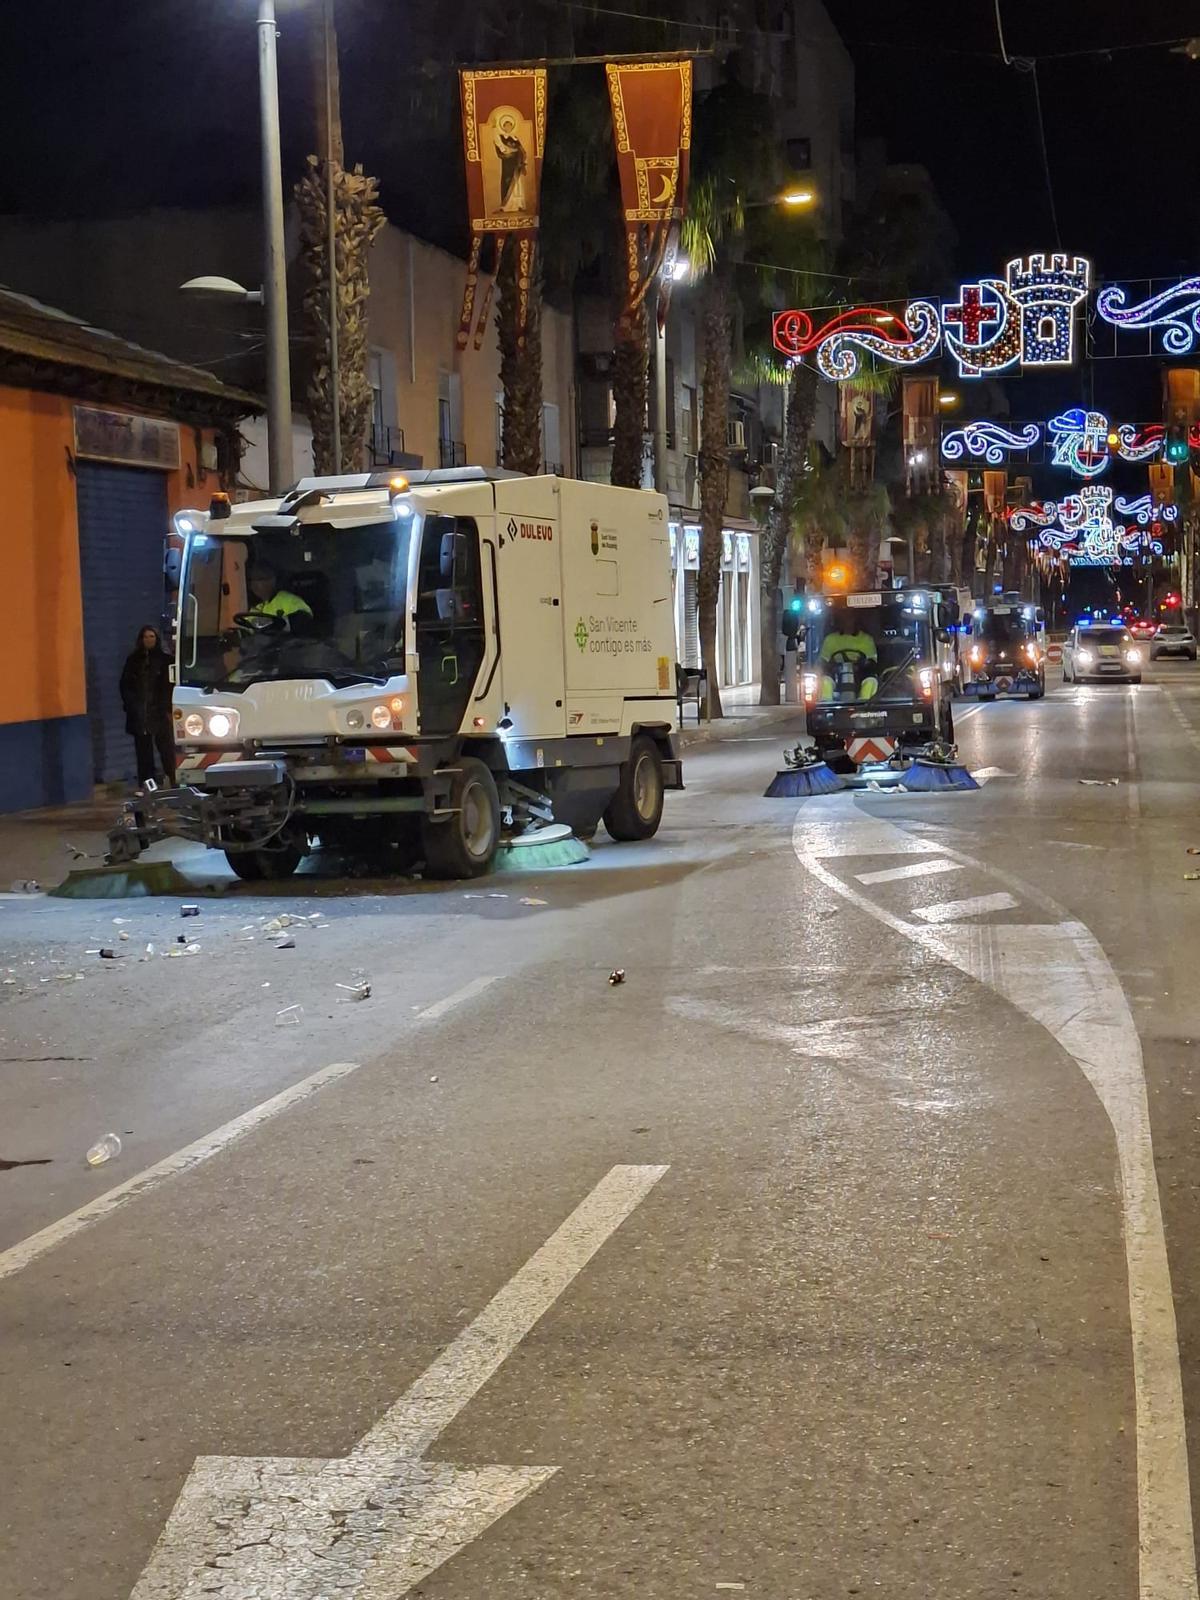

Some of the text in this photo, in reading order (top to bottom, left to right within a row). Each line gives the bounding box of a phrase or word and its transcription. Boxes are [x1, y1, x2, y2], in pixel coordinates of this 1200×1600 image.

[520, 523, 553, 541] DULEVO
[589, 616, 637, 632] San Vicente
[589, 637, 652, 656] contigo es más
